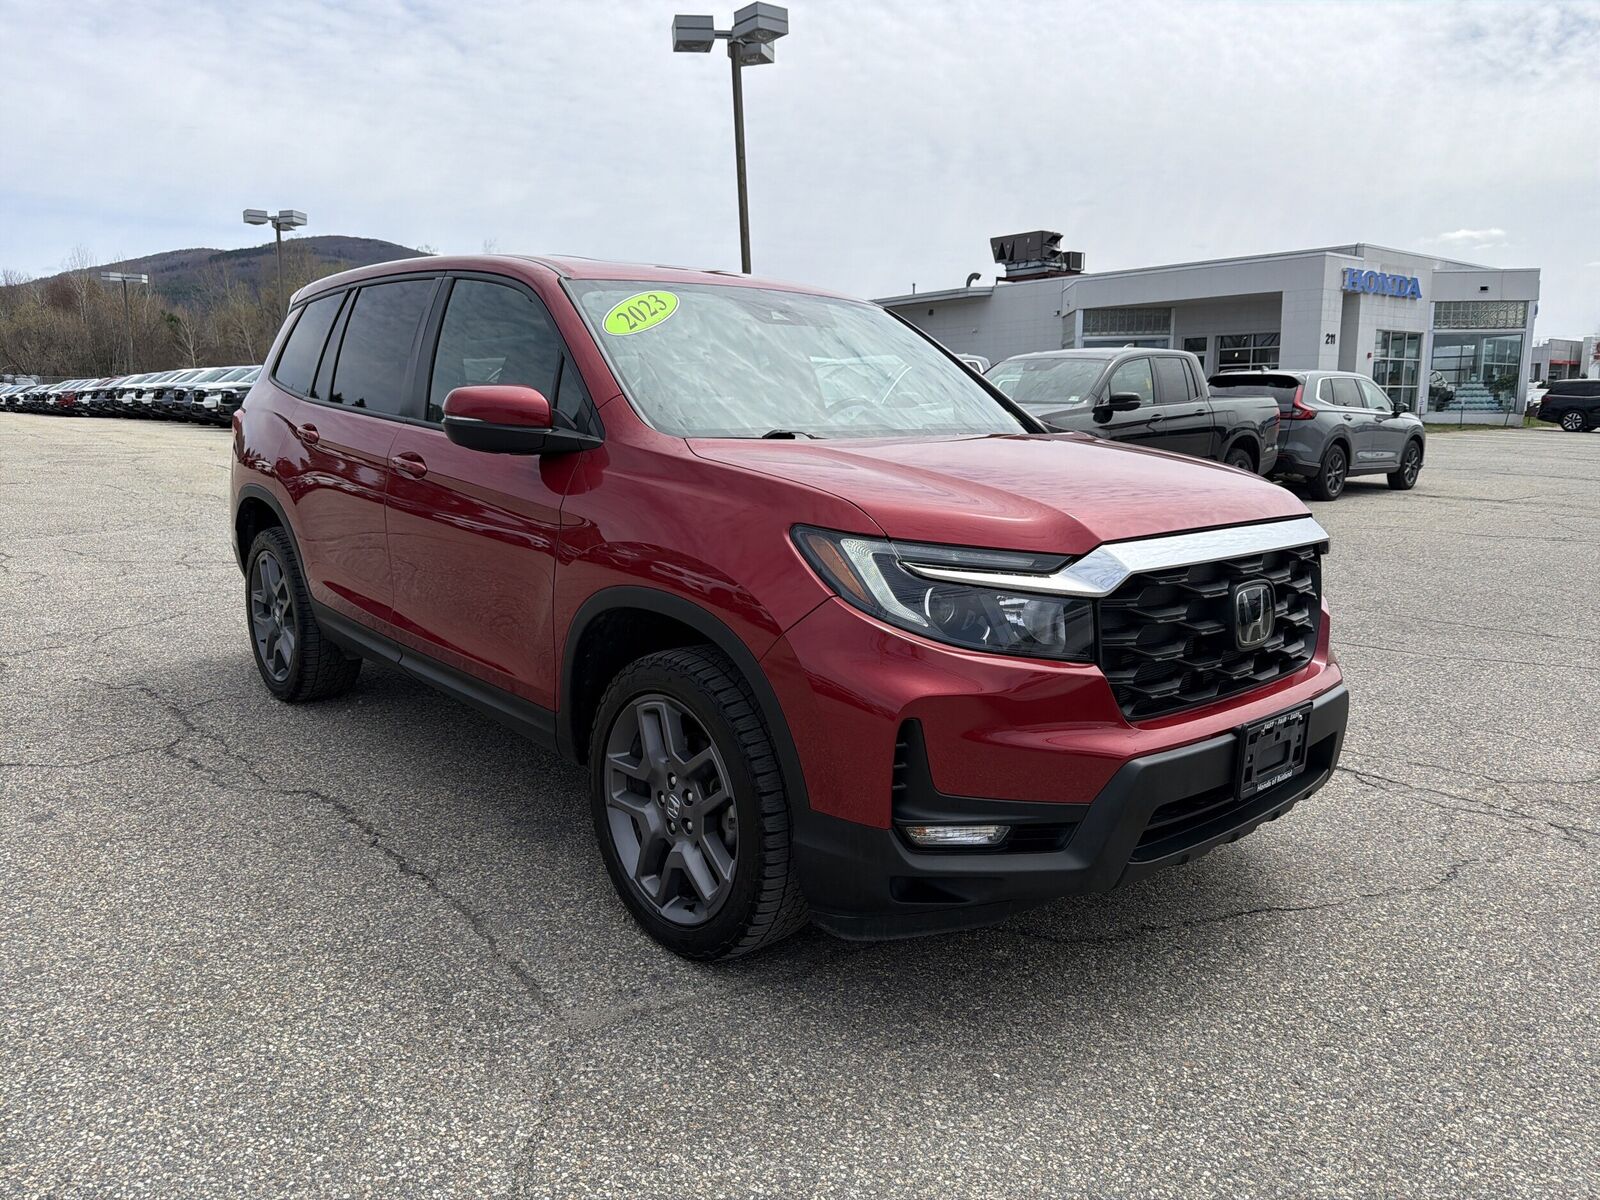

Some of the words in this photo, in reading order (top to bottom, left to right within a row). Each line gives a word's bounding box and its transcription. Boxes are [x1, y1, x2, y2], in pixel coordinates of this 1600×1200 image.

[1341, 267, 1422, 299] HONDA
[616, 294, 667, 330] 2023
[1325, 333, 1336, 345] 211
